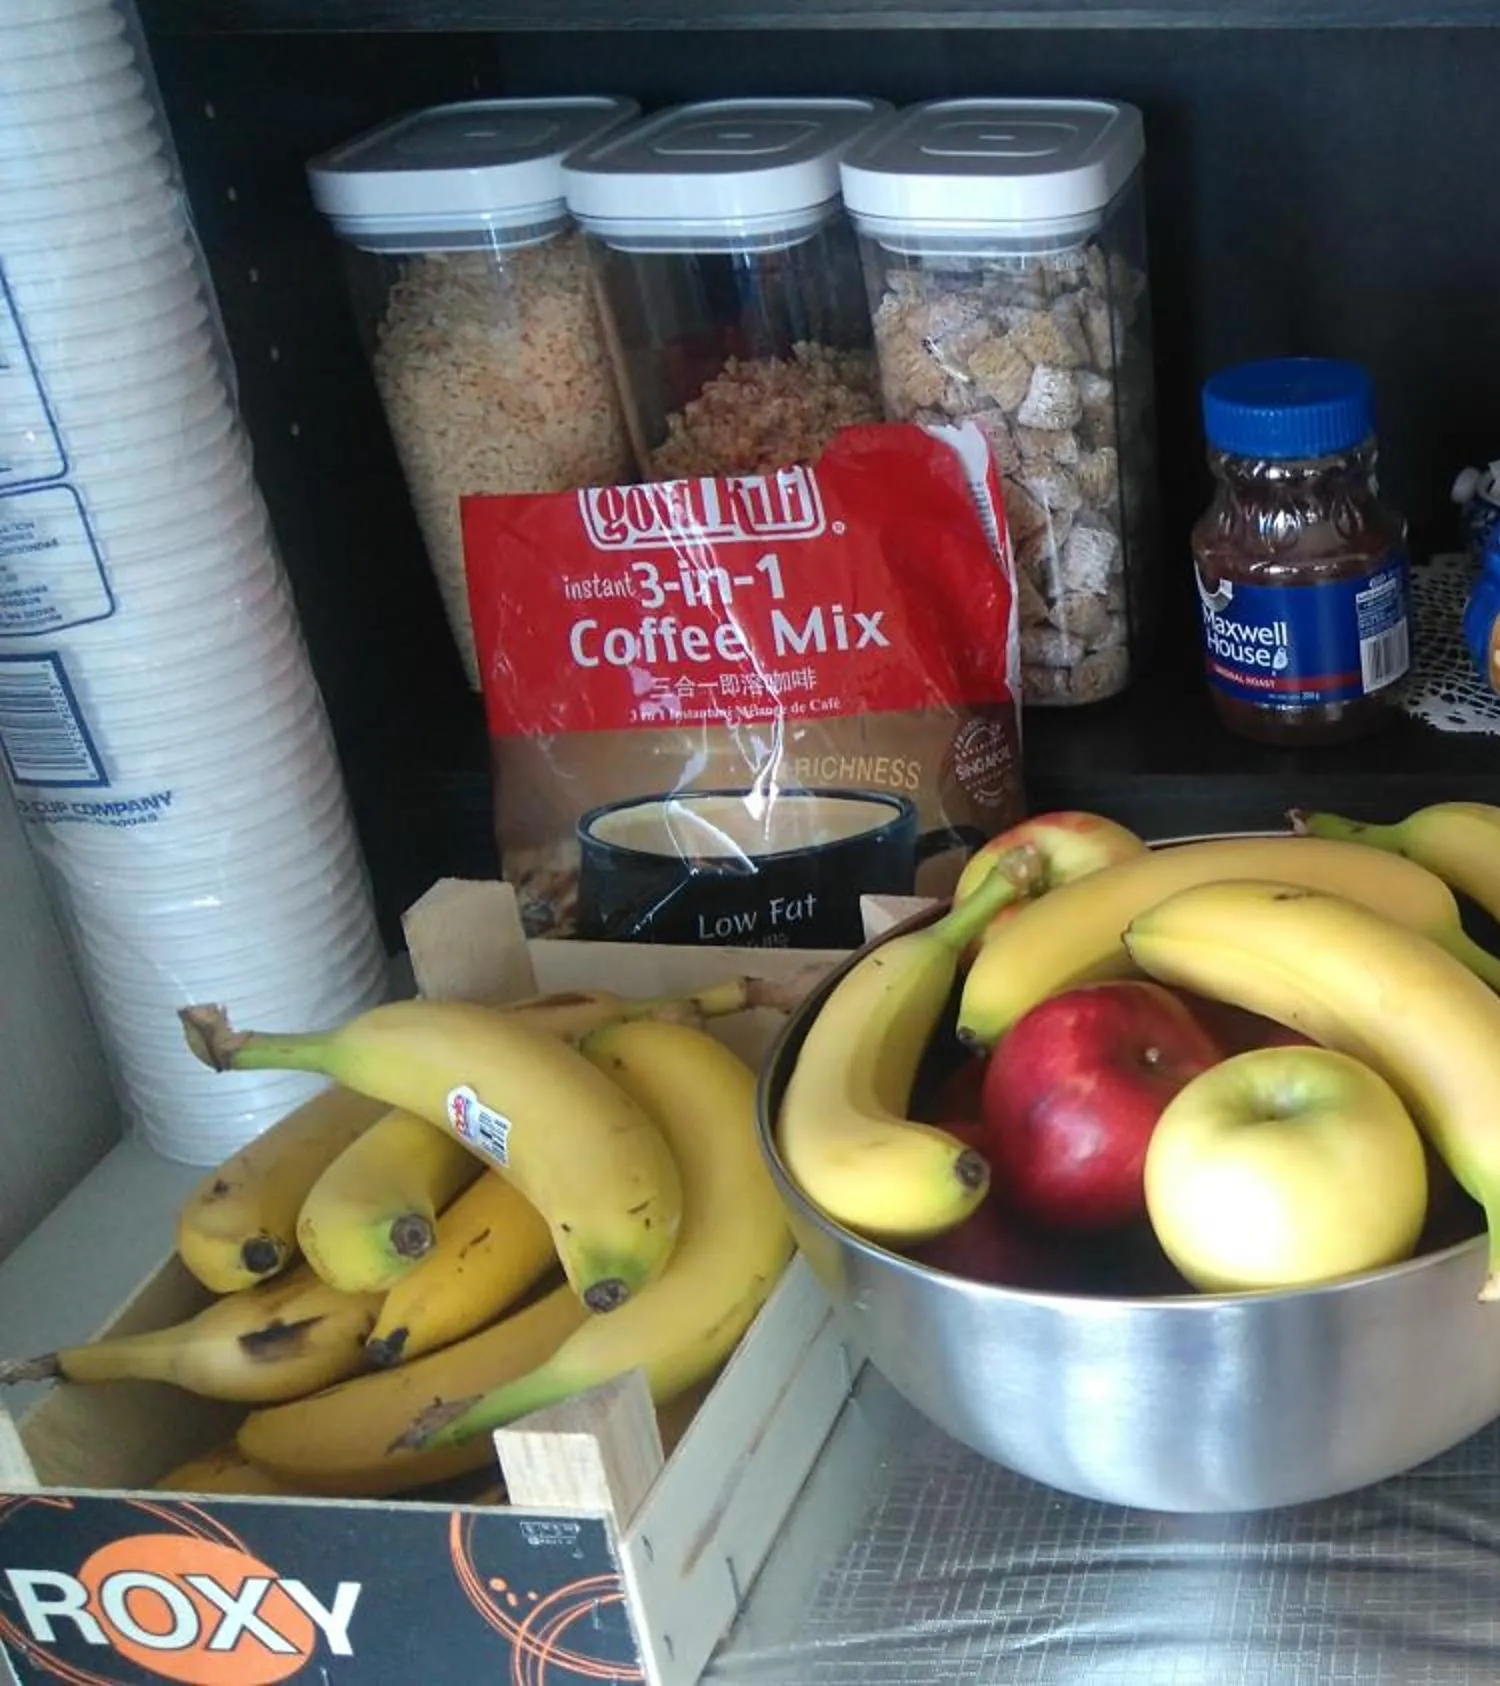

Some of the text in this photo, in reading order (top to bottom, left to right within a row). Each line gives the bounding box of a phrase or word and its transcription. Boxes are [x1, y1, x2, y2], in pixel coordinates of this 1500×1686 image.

[564, 553, 785, 609] instant 3-in-1
[569, 604, 891, 667] Coffee Mix
[1203, 604, 1287, 646] Maxwell
[1207, 634, 1271, 667] House
[794, 756, 922, 790] RICHNESS
[72, 790, 173, 817] COMPANY
[769, 893, 816, 925] Fat
[3, 1567, 362, 1657] ROXY
